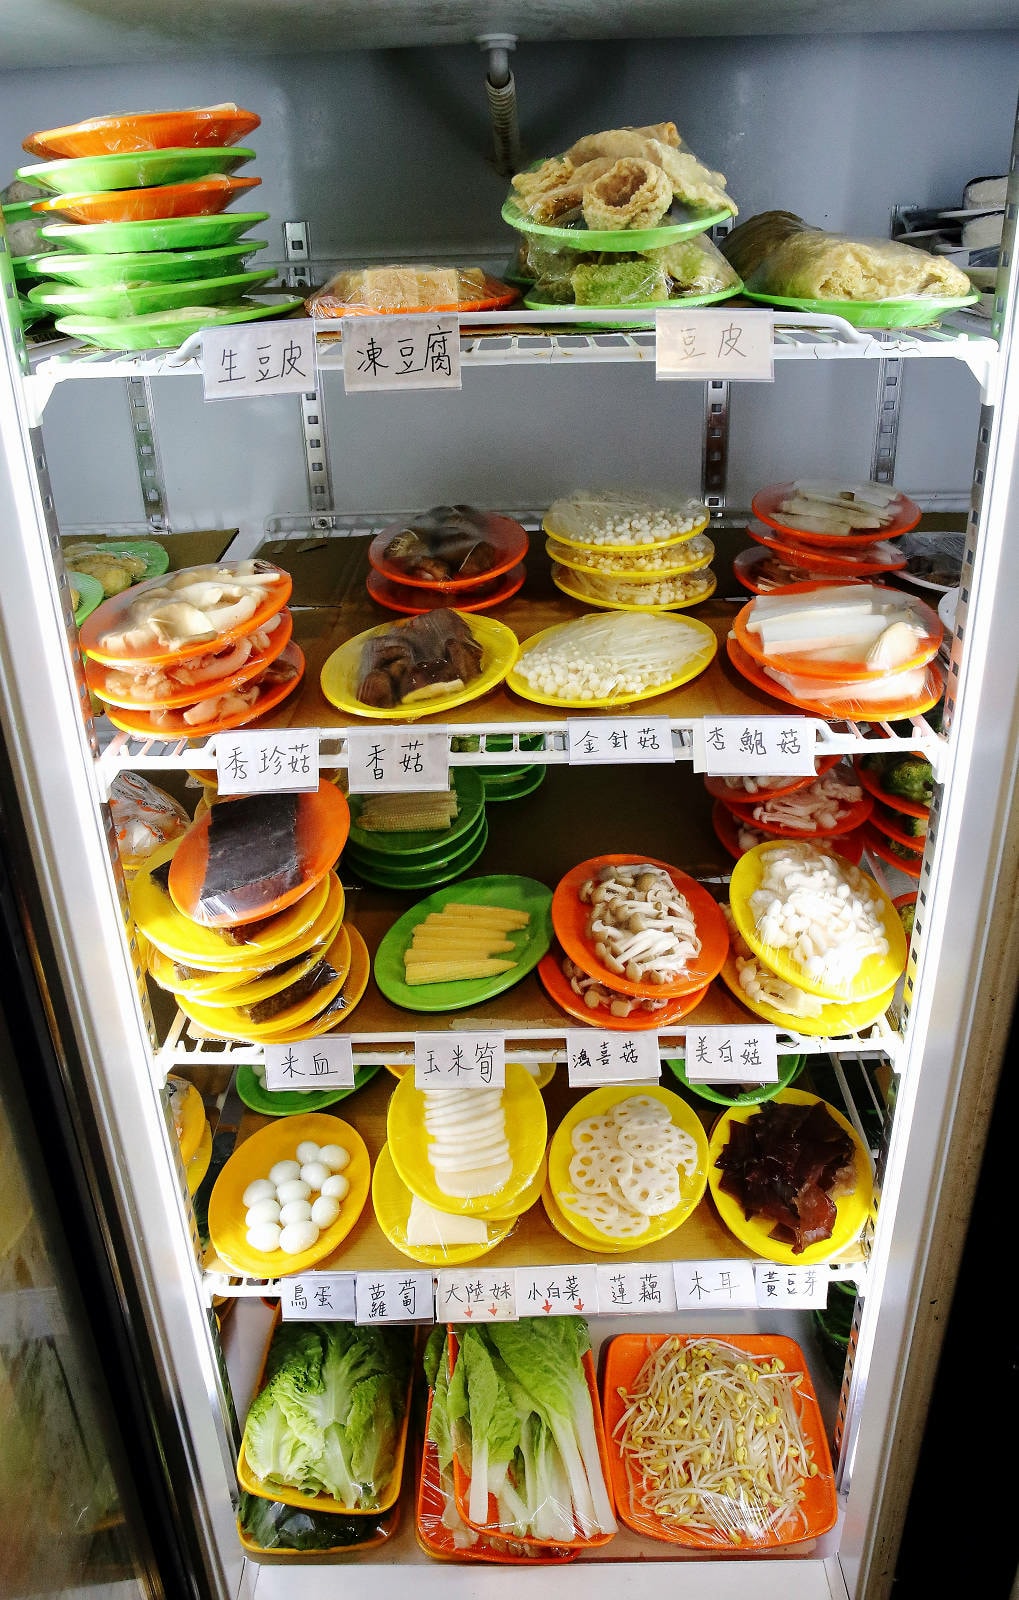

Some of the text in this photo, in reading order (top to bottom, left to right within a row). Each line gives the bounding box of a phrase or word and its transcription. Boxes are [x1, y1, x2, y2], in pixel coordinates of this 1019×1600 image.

[679, 323, 747, 361] 豆皮
[218, 340, 307, 383] 生豆皮
[574, 727, 661, 754] 金針菇
[706, 727, 801, 756] 杏鮑菇
[225, 743, 310, 780] 秀珍菇
[365, 741, 424, 780] 香菇
[281, 1047, 339, 1079] 米血
[424, 1042, 498, 1084] 玉米筍
[572, 1041, 640, 1069] 鴻喜菇
[696, 1036, 762, 1066] 美白菇
[291, 1284, 334, 1310] 鳥蛋
[369, 1279, 417, 1318] 蘿蔔
[445, 1280, 513, 1304] 大陸妹
[527, 1275, 581, 1301] 小白菜
[610, 1273, 662, 1305] 蓮藕
[689, 1270, 737, 1301] 木耳
[761, 1270, 819, 1297] 黃豆芽
